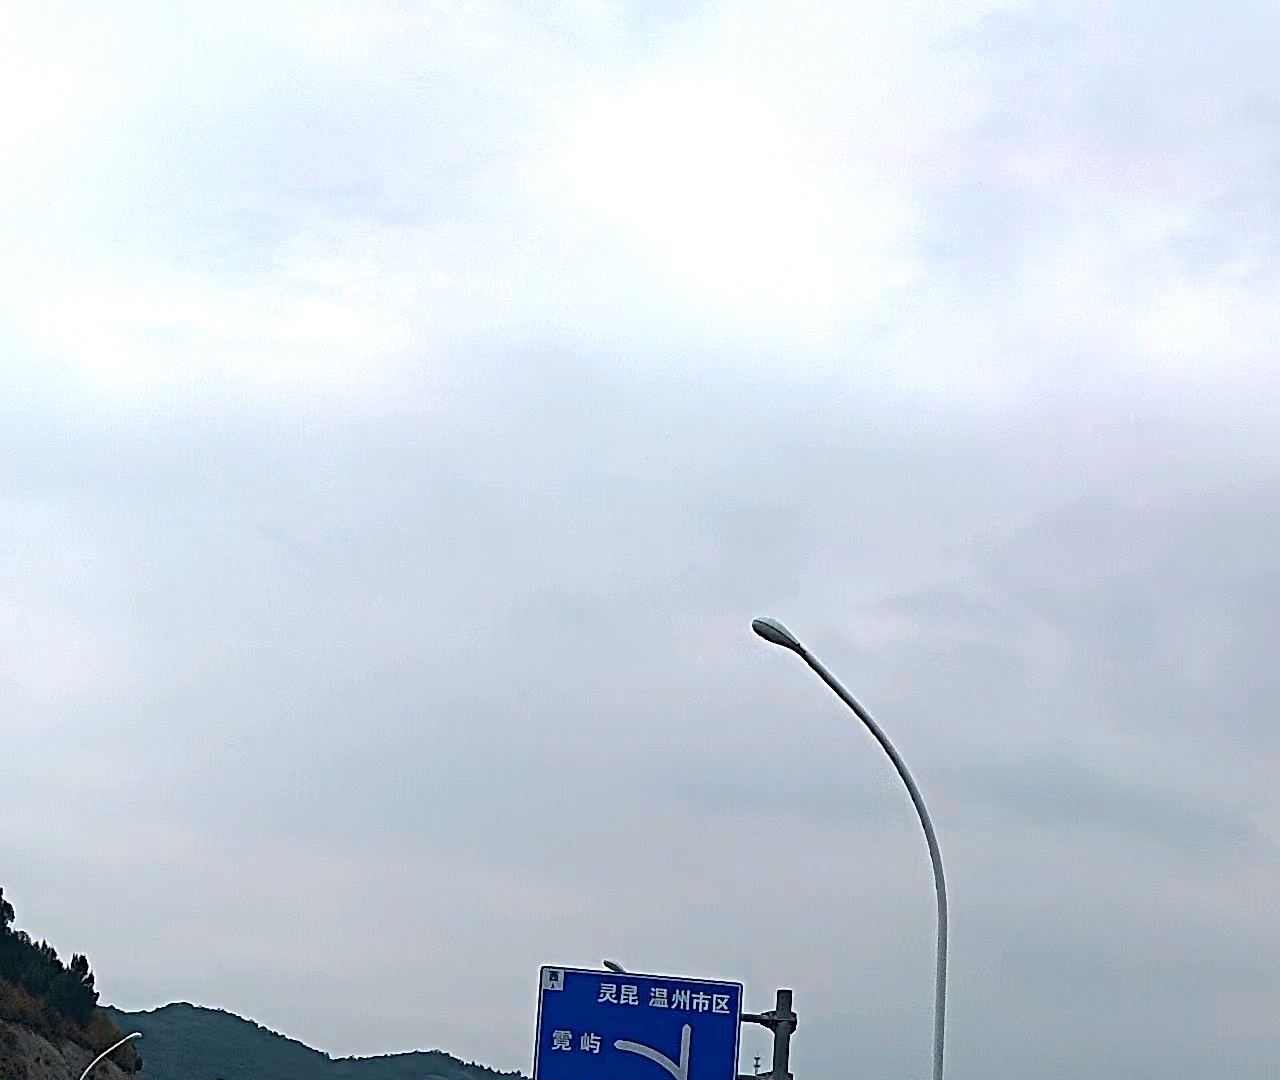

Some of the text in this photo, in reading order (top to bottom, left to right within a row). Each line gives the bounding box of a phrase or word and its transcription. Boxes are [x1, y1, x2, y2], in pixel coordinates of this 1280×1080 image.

[597, 983, 731, 1014] 灵昆 温州市区
